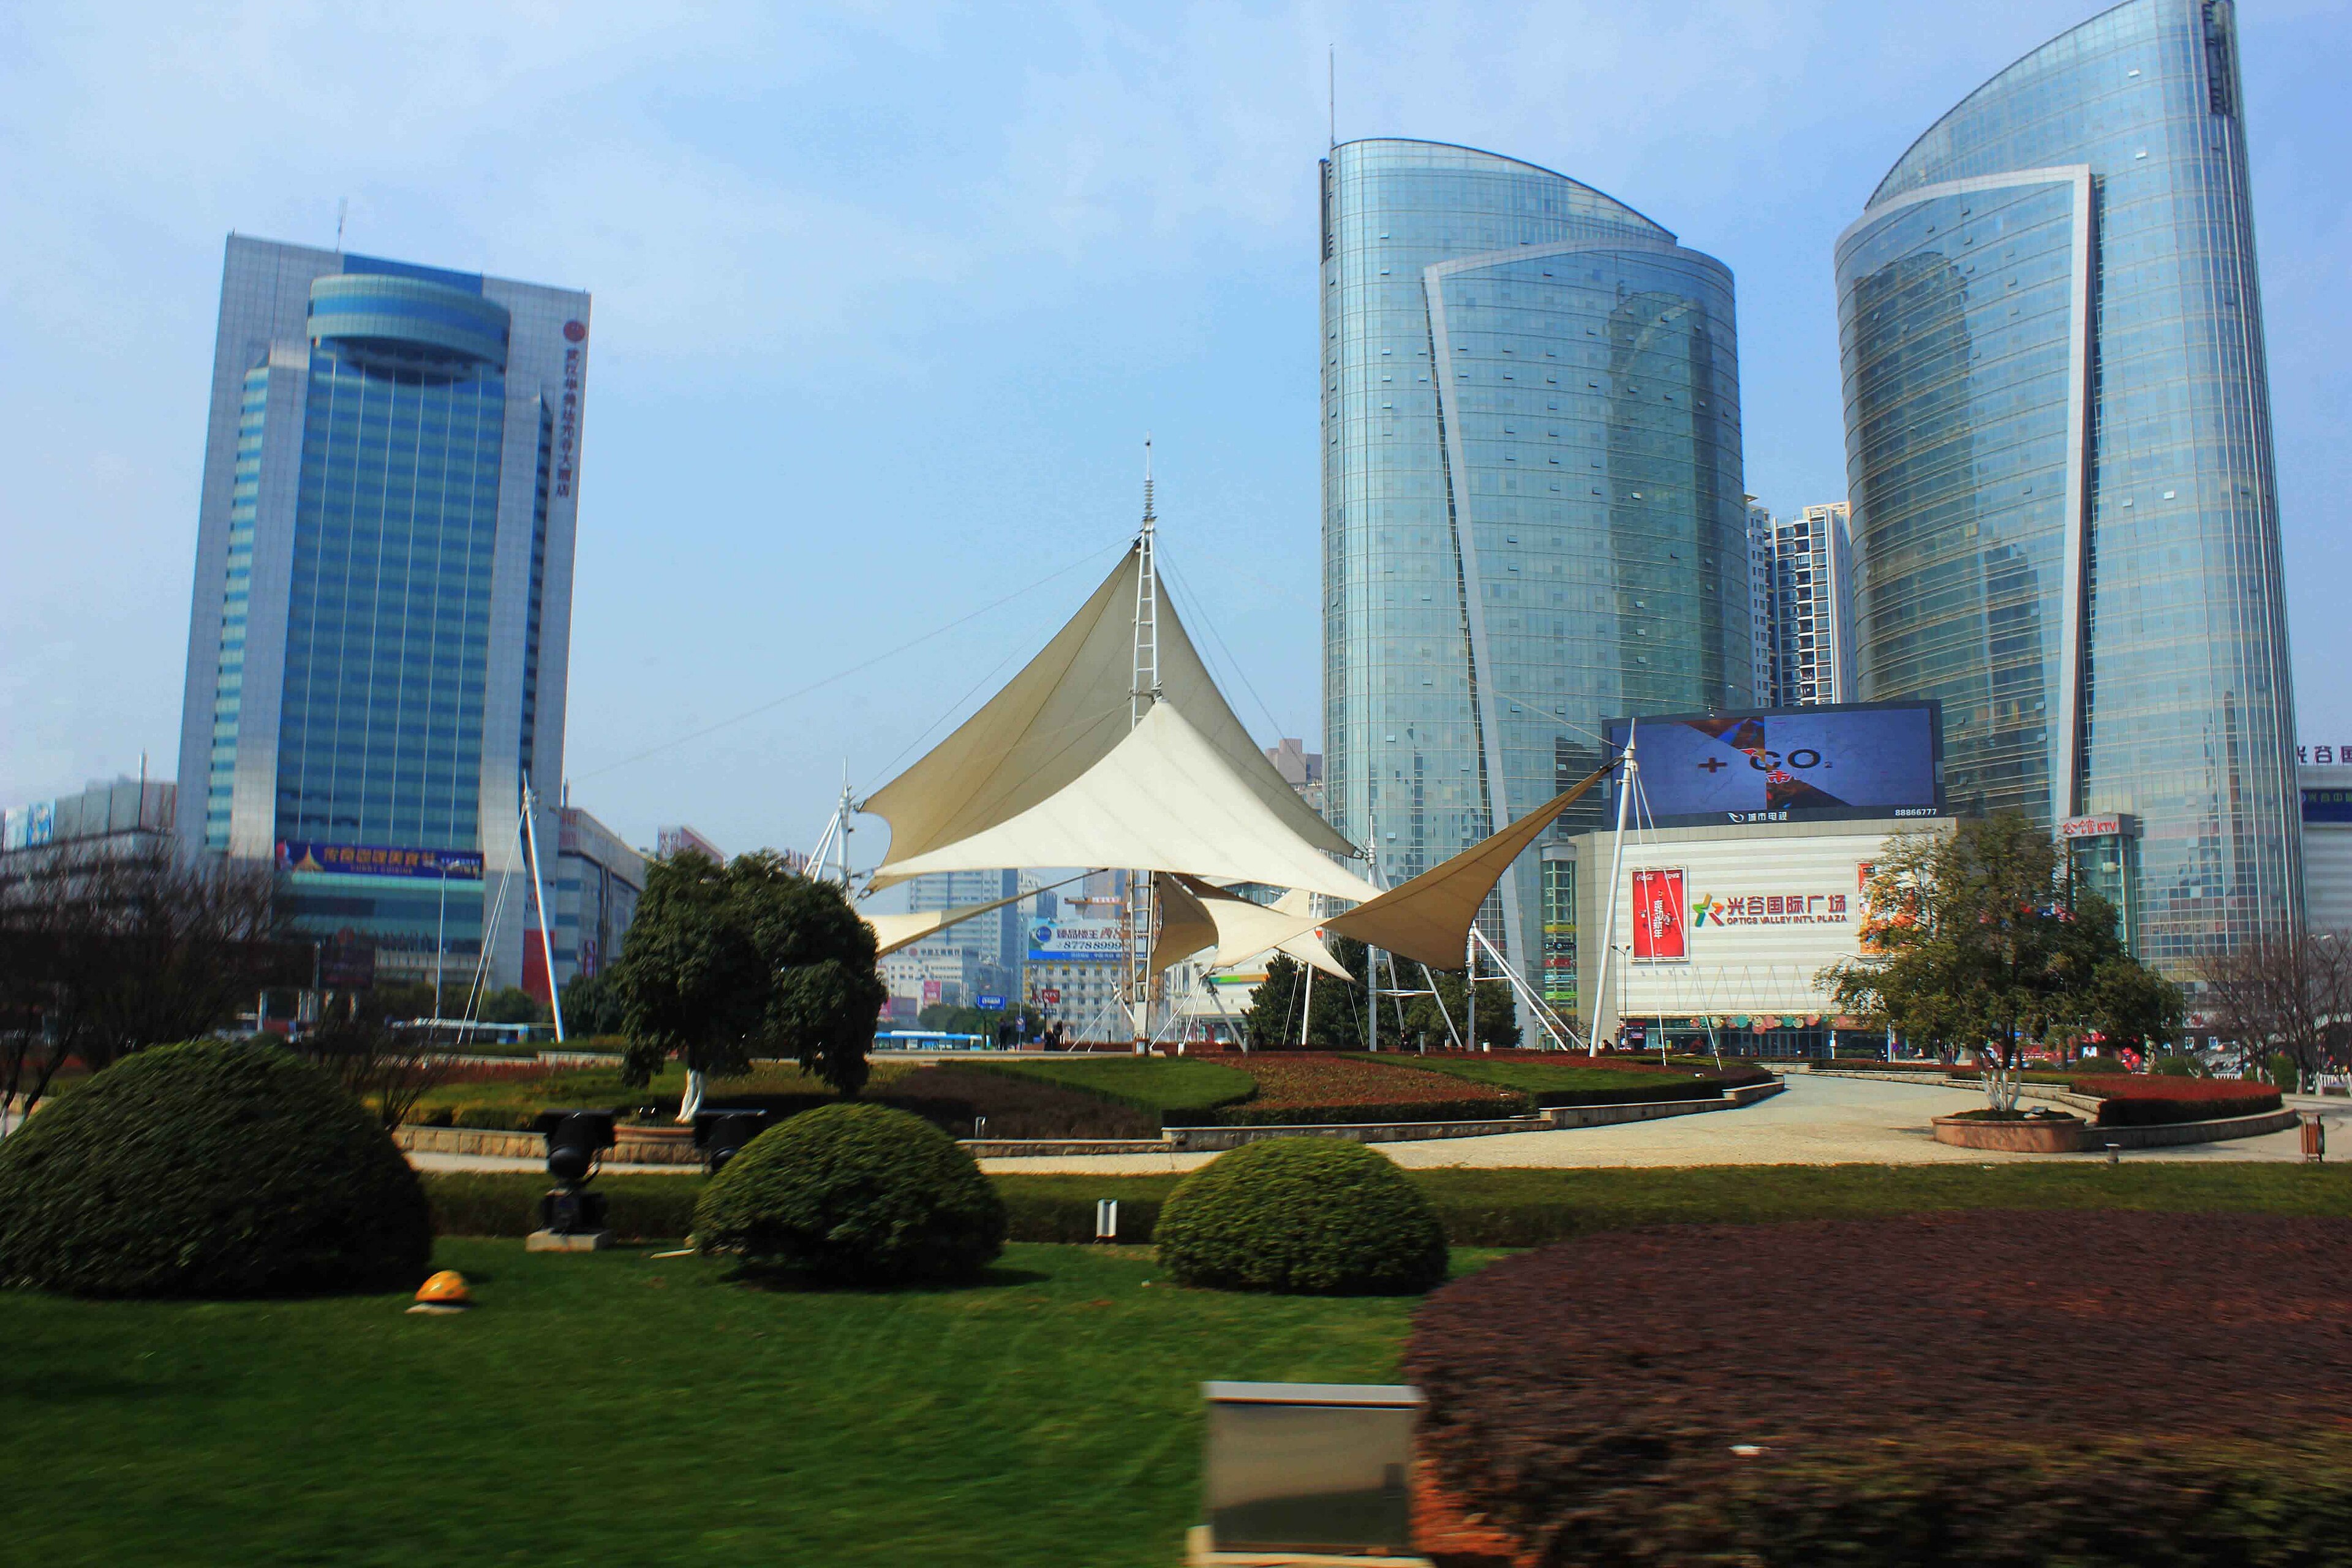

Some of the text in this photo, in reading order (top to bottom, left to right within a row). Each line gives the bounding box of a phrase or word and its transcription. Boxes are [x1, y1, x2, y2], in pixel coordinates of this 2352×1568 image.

[1747, 812, 1787, 821] 城市电视
[2097, 821, 2117, 832] KTV
[1727, 894, 1846, 916] 光谷国际广场
[1727, 917, 1758, 925] OPTICS
[1761, 916, 1792, 924] VALLEY
[1817, 914, 1847, 924] PLAZA
